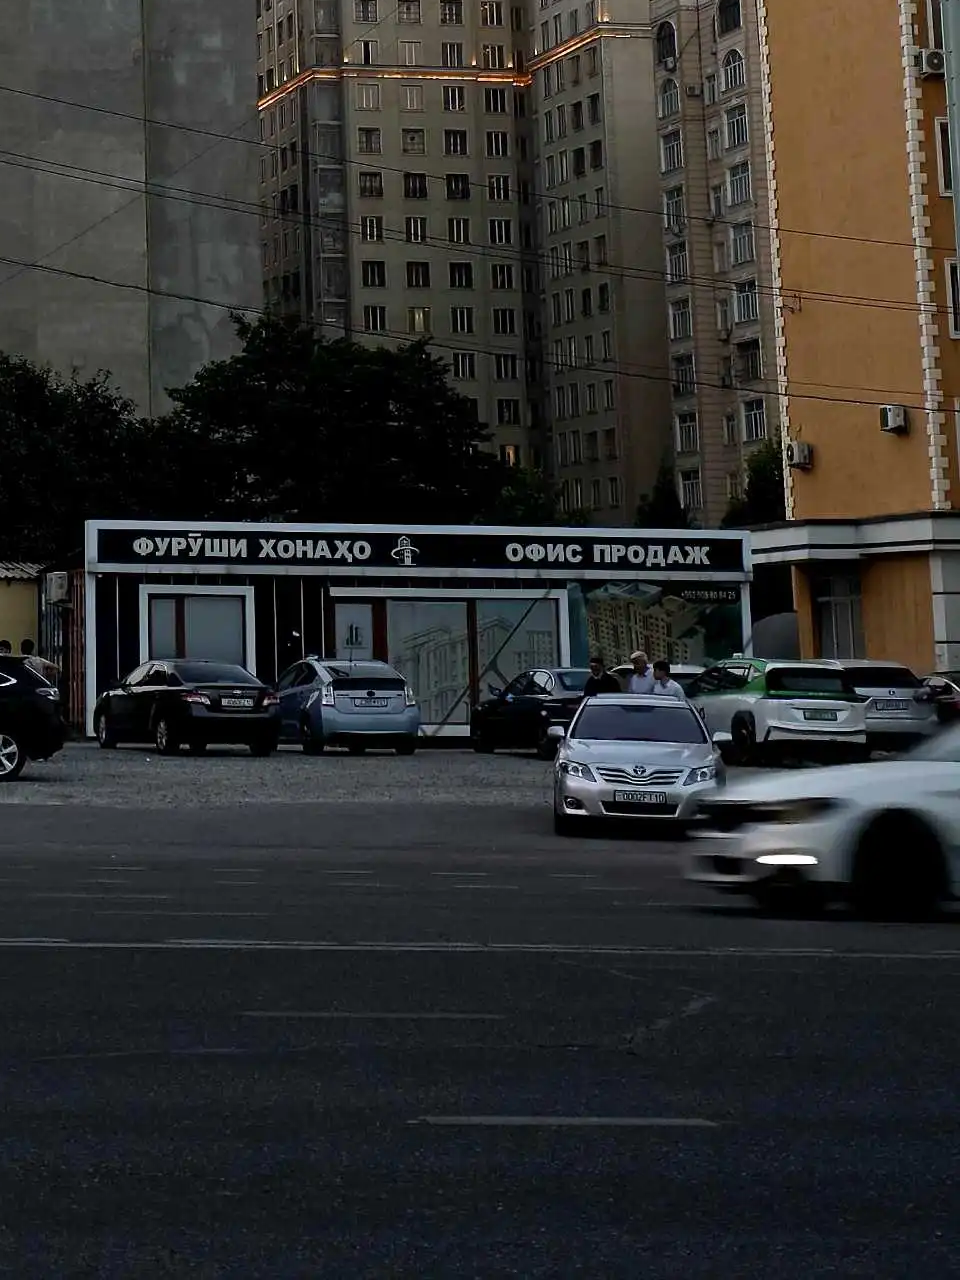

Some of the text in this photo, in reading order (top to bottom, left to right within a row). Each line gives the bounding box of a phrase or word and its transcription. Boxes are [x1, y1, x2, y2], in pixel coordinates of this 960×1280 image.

[132, 532, 372, 563] ФУРӮШИ ХОНАҲО
[505, 542, 711, 567] ОФИС ПРОДАЖ
